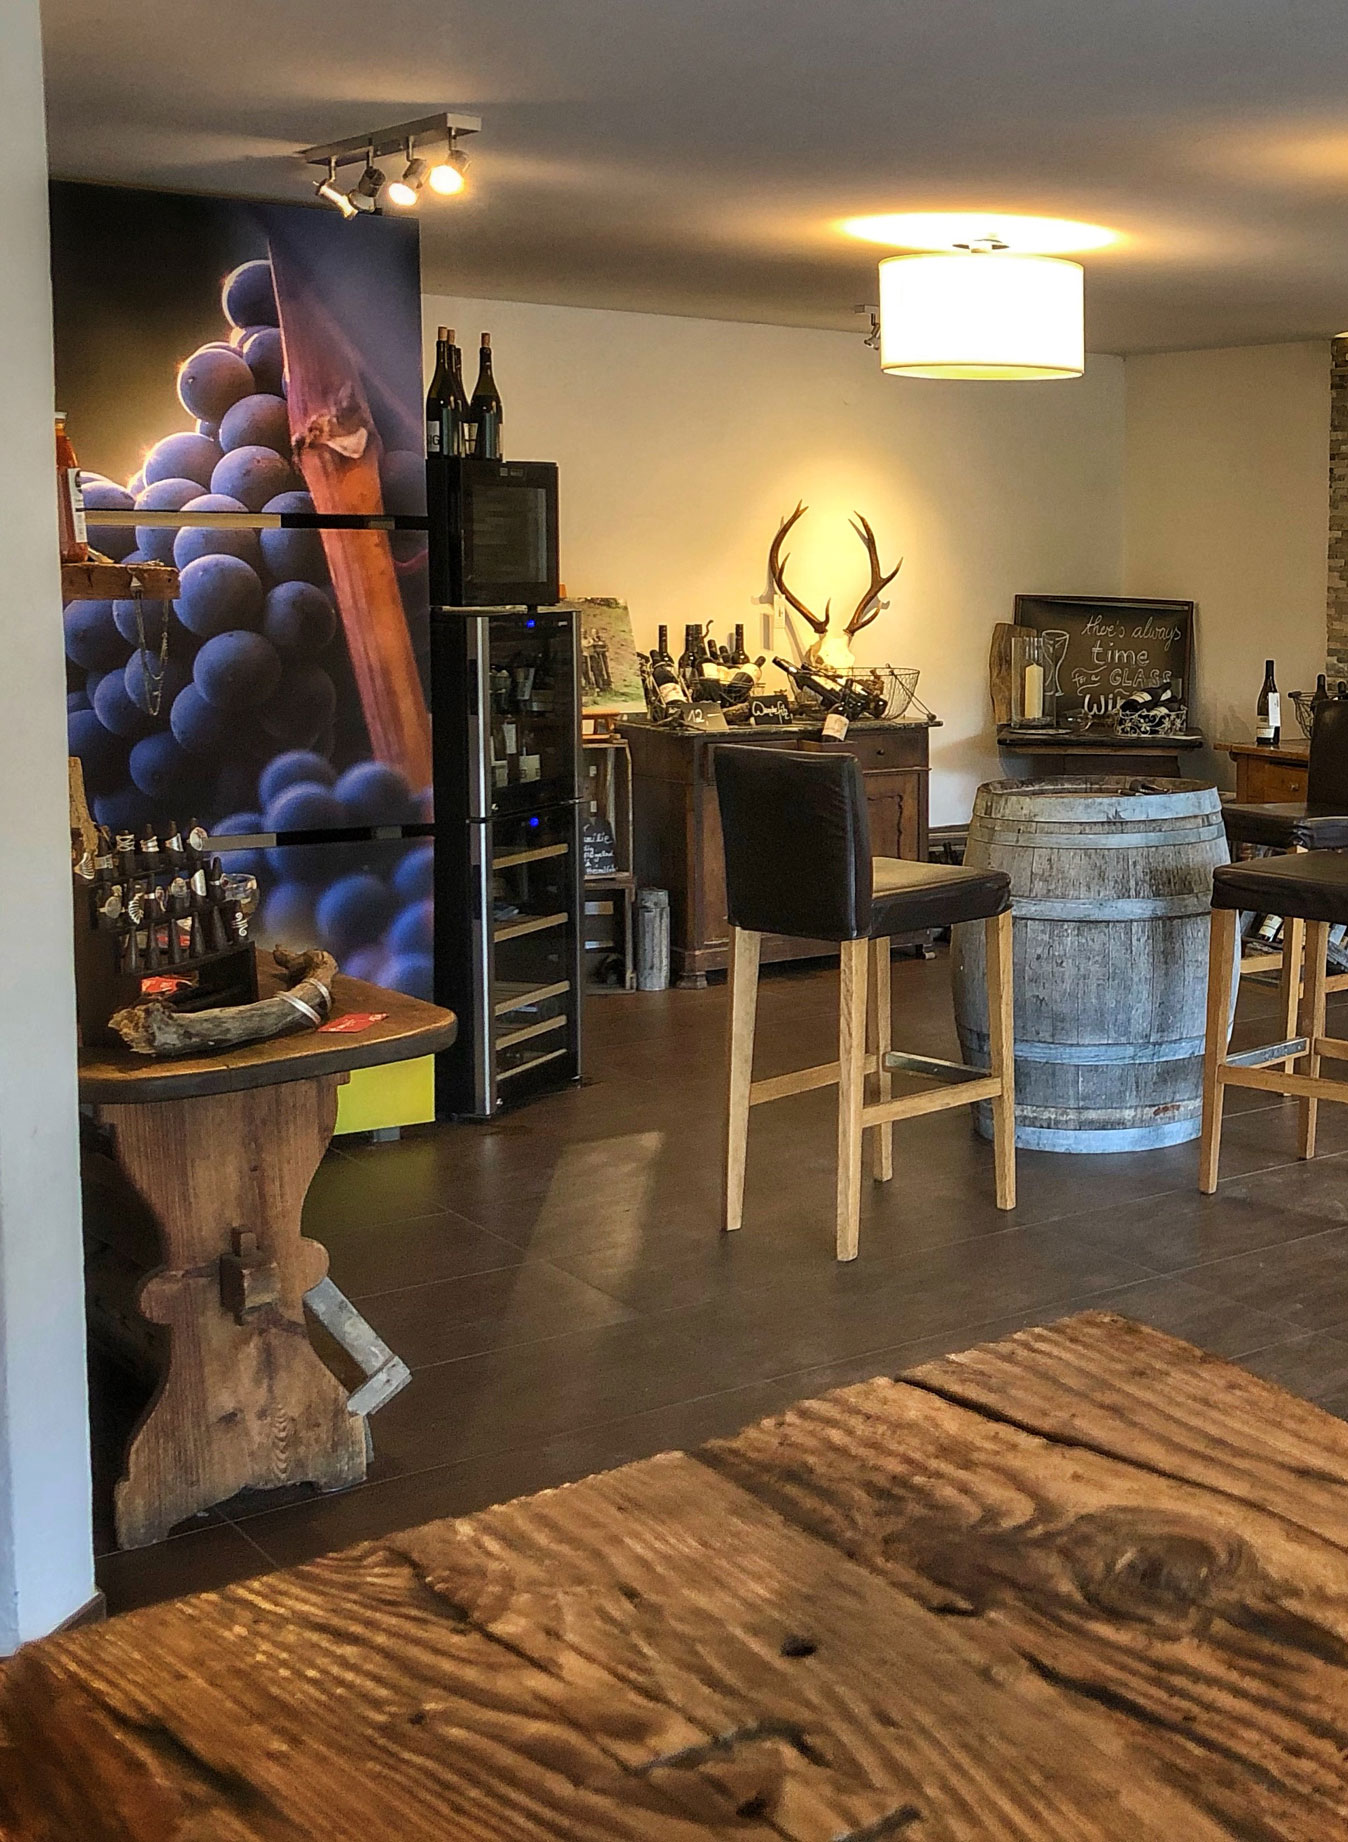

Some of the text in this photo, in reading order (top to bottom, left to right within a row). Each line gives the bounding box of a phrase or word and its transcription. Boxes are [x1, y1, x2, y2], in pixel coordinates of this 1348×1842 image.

[1131, 616, 1182, 652] always
[1091, 640, 1150, 667] time
[1071, 667, 1172, 688] for a GLASS
